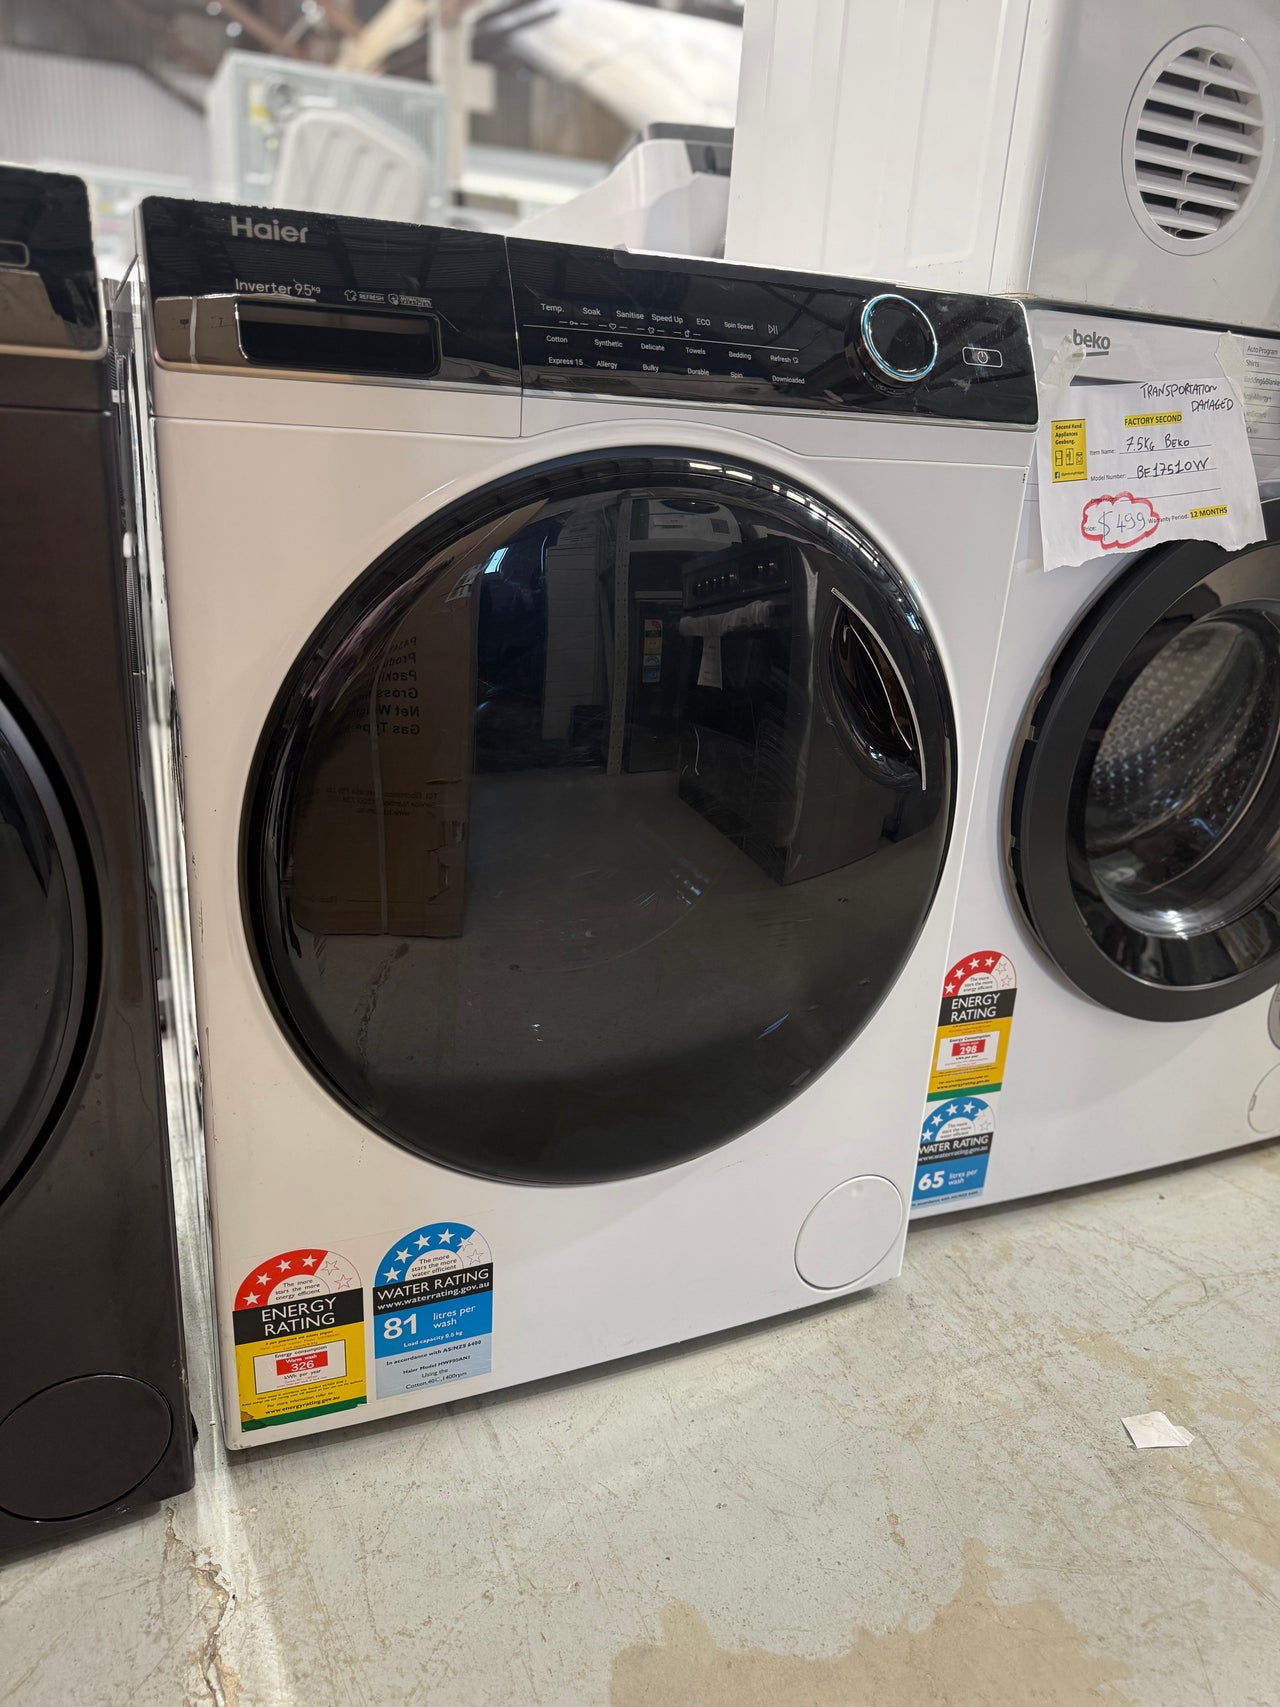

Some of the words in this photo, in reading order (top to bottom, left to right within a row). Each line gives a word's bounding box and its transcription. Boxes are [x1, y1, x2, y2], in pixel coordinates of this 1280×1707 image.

[231, 215, 308, 244] Haier
[235, 278, 292, 295] Inverter
[540, 303, 565, 313] Temp.
[582, 307, 601, 316] Soak
[616, 310, 645, 320] Sanitise
[651, 313, 672, 323] Speed
[673, 315, 683, 324] Up
[696, 318, 711, 326] ECO
[724, 321, 735, 329] Spin
[736, 322, 754, 331] Speed
[546, 335, 568, 344] Cotton
[594, 338, 623, 349] Synthetic
[1073, 329, 1110, 350] beko
[641, 343, 665, 352] Delicate
[685, 347, 706, 356] Towels
[548, 356, 573, 366] Express
[575, 358, 584, 366] 15
[728, 351, 752, 361] Bedding
[770, 355, 791, 364] Refresh
[596, 360, 618, 370] Allergy
[642, 364, 659, 373] Bulky
[687, 368, 710, 377] Durable
[730, 371, 743, 380] Spin
[772, 375, 805, 385] Downloaded
[1140, 382, 1217, 399] TRANSPORTATION
[1191, 398, 1234, 412] DAMAGED
[1125, 415, 1154, 426] FACTORY
[1155, 413, 1182, 424] SECOND
[1200, 507, 1228, 517] MONTHS
[952, 993, 1000, 1010] ENERGY
[951, 1006, 997, 1022] RATING
[960, 1046, 977, 1055] 298
[918, 1142, 950, 1154] WATER
[952, 1135, 989, 1149] RATING
[966, 1169, 978, 1177] per
[918, 1170, 945, 1191] 65
[948, 1178, 964, 1186] wash
[412, 1270, 430, 1278] water
[432, 1265, 457, 1274] efficient
[378, 1282, 430, 1300] WATER
[434, 1269, 489, 1290] RATING
[297, 1289, 320, 1297] efficient
[377, 1282, 490, 1310] www.waterrating.gov.au
[262, 1297, 337, 1322] ENERGY
[264, 1313, 335, 1336] RATING
[383, 1313, 417, 1339] 81
[433, 1309, 457, 1320] litres
[460, 1305, 476, 1316] per
[433, 1318, 457, 1329] wash
[420, 1335, 444, 1344] capacity
[295, 1346, 327, 1355] consumption
[394, 1354, 428, 1364] accordance
[291, 1361, 314, 1372] 326
